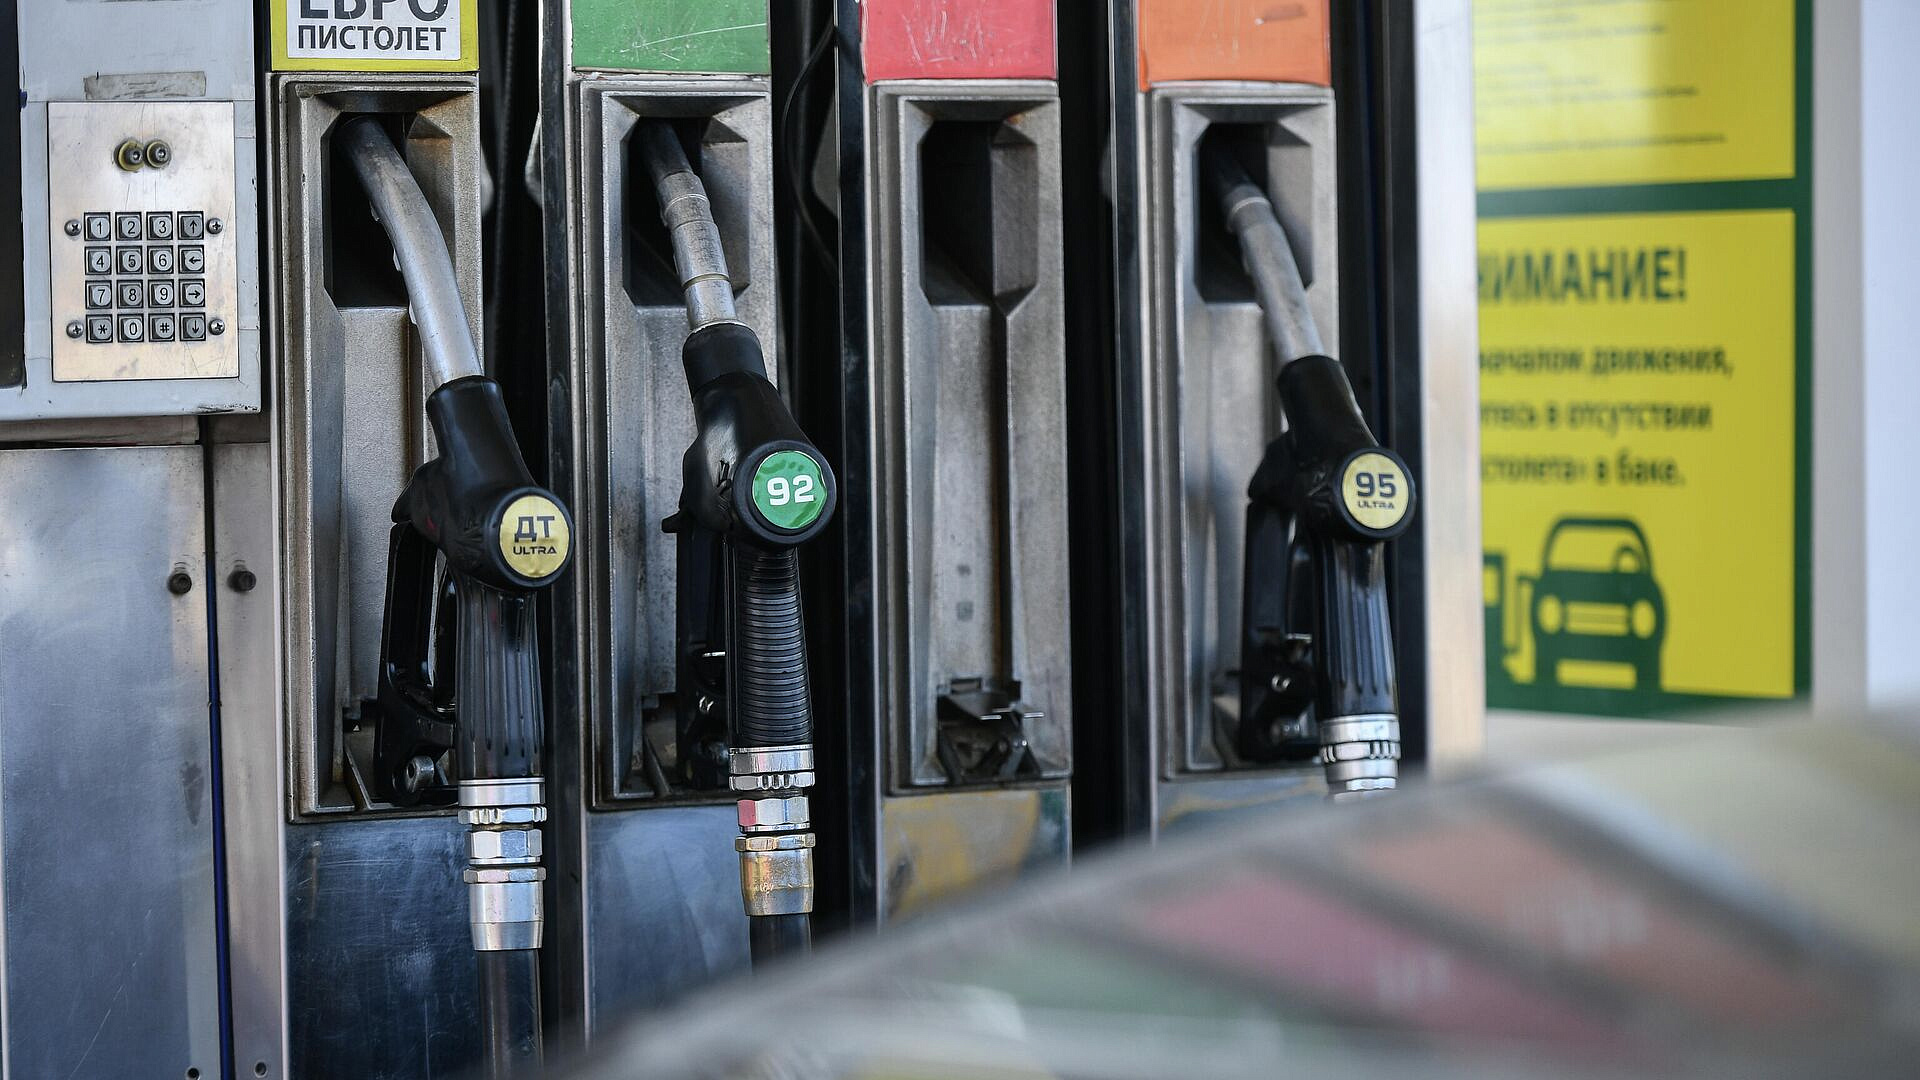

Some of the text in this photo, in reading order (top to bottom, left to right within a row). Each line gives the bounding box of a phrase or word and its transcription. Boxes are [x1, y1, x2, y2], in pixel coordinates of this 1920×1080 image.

[298, 25, 447, 51] ПИСТОЛЕТ
[96, 220, 167, 235] 1 2 3
[96, 253, 168, 268] 4 5 6
[97, 287, 168, 303] 7 8 9
[1589, 347, 1733, 379] движения,
[1568, 401, 1712, 437] отсутствии
[1481, 455, 1587, 484] столета»
[767, 474, 815, 506] 92
[1356, 472, 1396, 498] 95
[1357, 501, 1395, 509] ULTRA
[514, 515, 555, 543] ДТ
[512, 546, 557, 555] ULTRA
